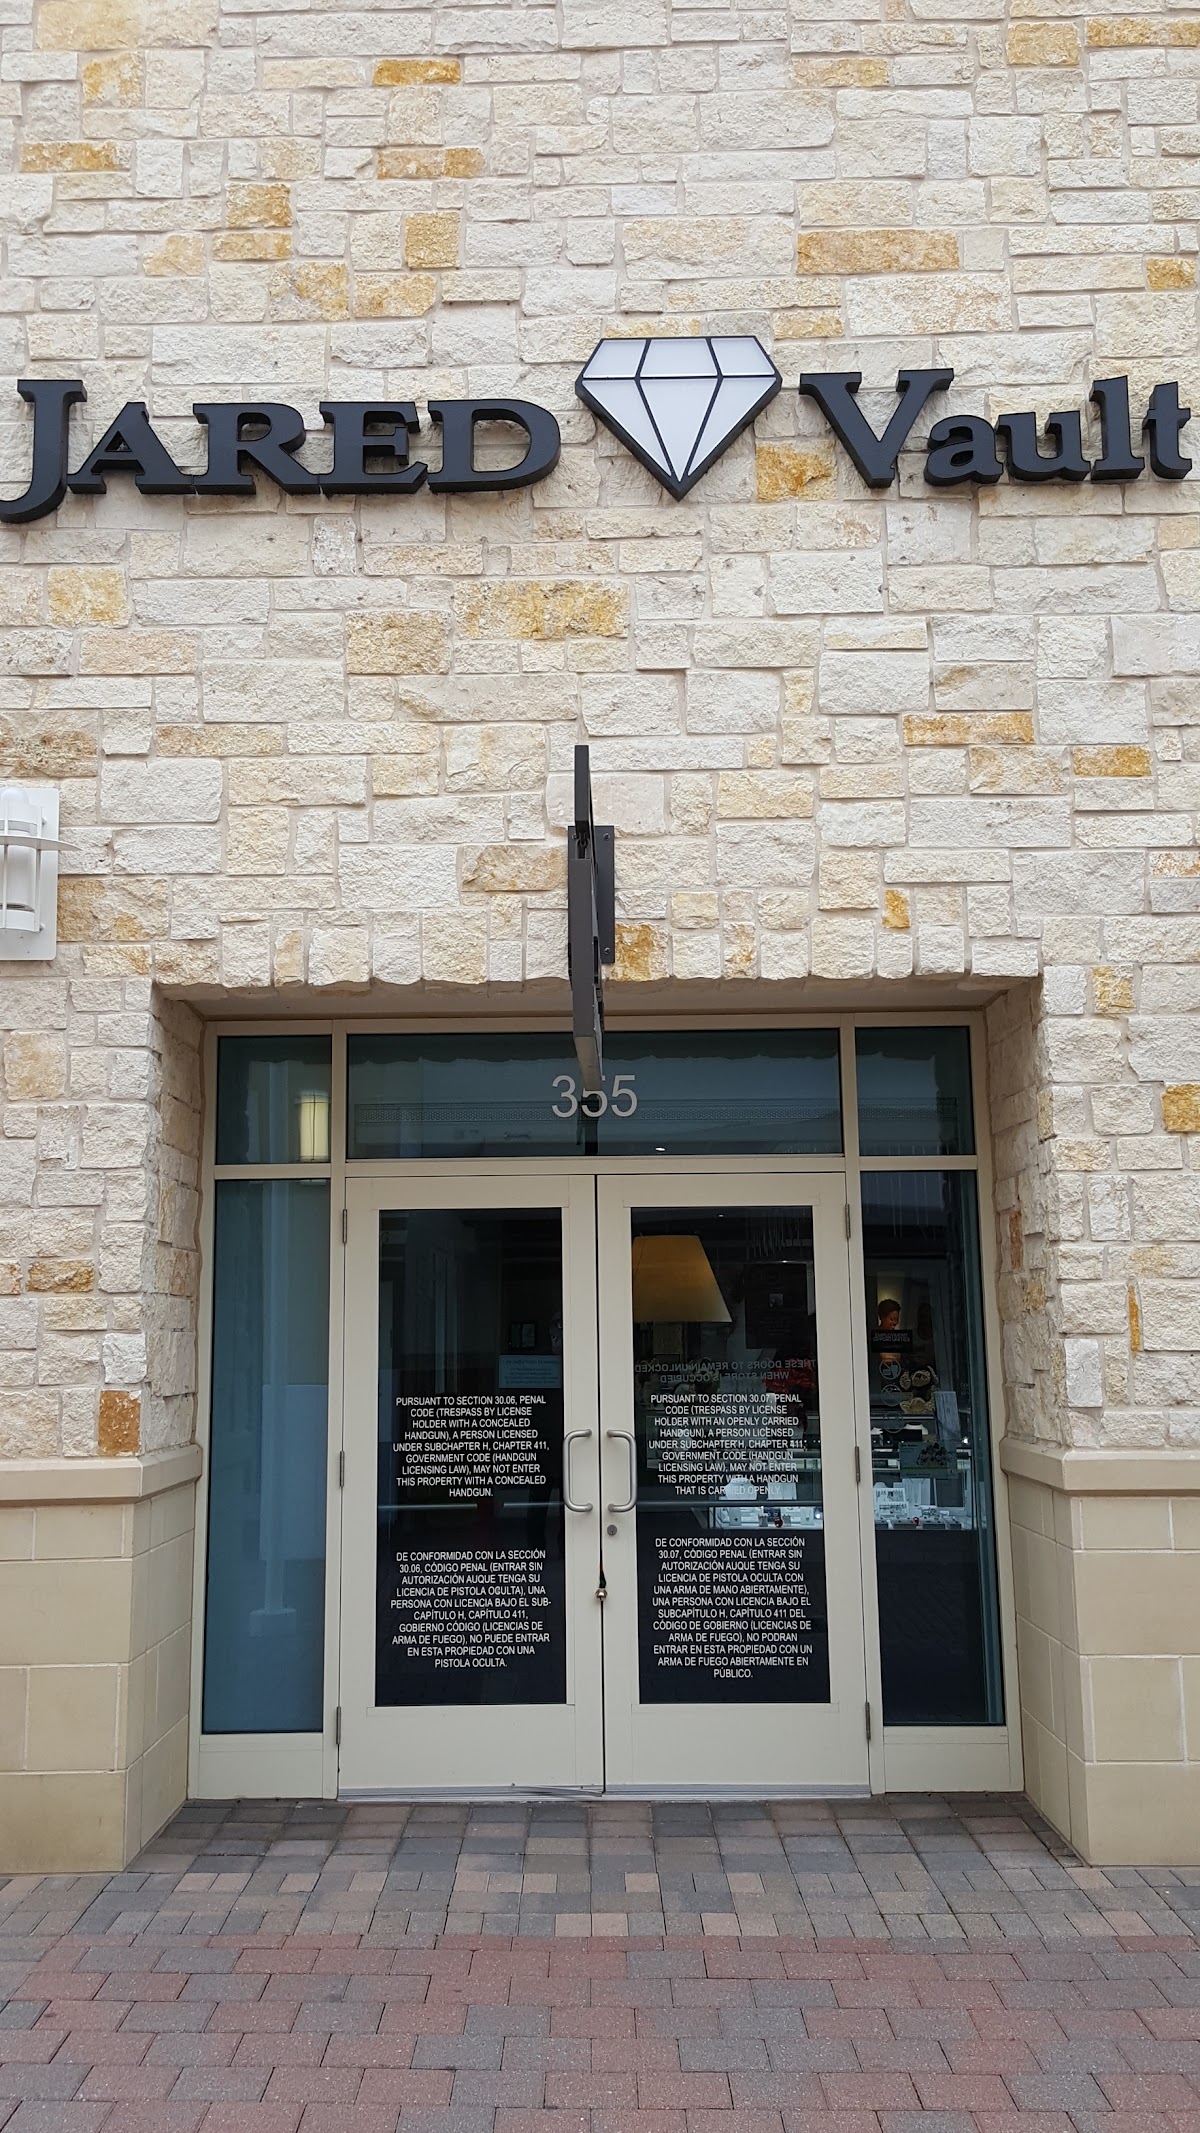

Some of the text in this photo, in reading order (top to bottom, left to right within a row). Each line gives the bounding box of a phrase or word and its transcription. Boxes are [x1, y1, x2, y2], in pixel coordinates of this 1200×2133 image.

[0, 367, 1192, 523] JARED Vault
[552, 1074, 637, 1117] 355
[396, 1396, 546, 1406] PURSUANT TO SECTION 30.06, PENAL
[650, 1394, 695, 1403] PURSUANT
[698, 1394, 709, 1402] TO
[711, 1394, 748, 1402] SECTION
[774, 1394, 801, 1402] PENAL
[410, 1407, 532, 1418] CODE (TRESPASS BY LICENSE
[665, 1405, 787, 1415] CODE (TRESPASS BY LICENSE
[413, 1418, 530, 1428] HOLDER WITH A CONCEALED
[655, 1416, 798, 1426] HOLDER WITH AN OPENLY CARRIED
[405, 1430, 538, 1441] HANDGUN), A PERSON LICENSED
[660, 1428, 794, 1438] HANDGUN), A PERSON LICENSED
[393, 1441, 549, 1451] UNDER SUBCHAPTER H, CHAPTER 411,
[406, 1453, 536, 1463] GOVERNMENT CODE (HANDGUN
[662, 1451, 793, 1460] GOVERNMENT CODE (HANDGUN
[402, 1464, 540, 1475] LICENSING LAW), MAY NOT ENTER
[659, 1462, 797, 1473] LICENSING LAW), MAY NOT ENTER
[396, 1477, 415, 1486] THIS
[417, 1477, 463, 1486] PROPERTY
[495, 1476, 546, 1485] CONCEALED
[449, 1488, 493, 1497] HANDGUN.
[656, 1536, 805, 1547] DE CONFORMIDAD CON LA SECCIÓN
[396, 1548, 545, 1561] DE CONFORMIDAD CON LA SECCIÓN
[658, 1548, 802, 1560] 30.07, CÓDIGO PENAL (ENTRAR SIN
[400, 1562, 543, 1574] 30.06, CÓDIGO PENAL (ENTRAR SIN
[661, 1560, 800, 1570] AUTORIZACIÓN AUQUE TENGA SU
[402, 1573, 540, 1585] AUTORIZACIÓN AUQUE TENGA SU
[658, 1573, 804, 1582] LICENCIA DE PISTOLA OCULTA CON
[397, 1586, 545, 1597] LICENCIA DE PISTOLA OCULTA), UNA
[654, 1585, 809, 1595] UNA ARMA DE MANO ABIERTAMENTE),
[391, 1598, 551, 1609] PERSONA CON LICENCIA BAJO EL SUB-
[652, 1597, 811, 1606] UNA PERSONA CON LICENCIA BAJO EL
[414, 1608, 528, 1620] CAPÍTULO H, CAPÍTULO 411,
[658, 1607, 806, 1619] SUBCAPÍTULO H, CAPÍTULO 411 DEL
[399, 1621, 543, 1633] GOBIERNO CÓDIGO (LICENCIAS DE
[653, 1619, 811, 1631] CÓDIGO DE GOBIERNO (LICENCIAS DE
[435, 1658, 507, 1668] PISTOLA OCULTA.
[714, 1667, 753, 1678] PÚBLICO.
